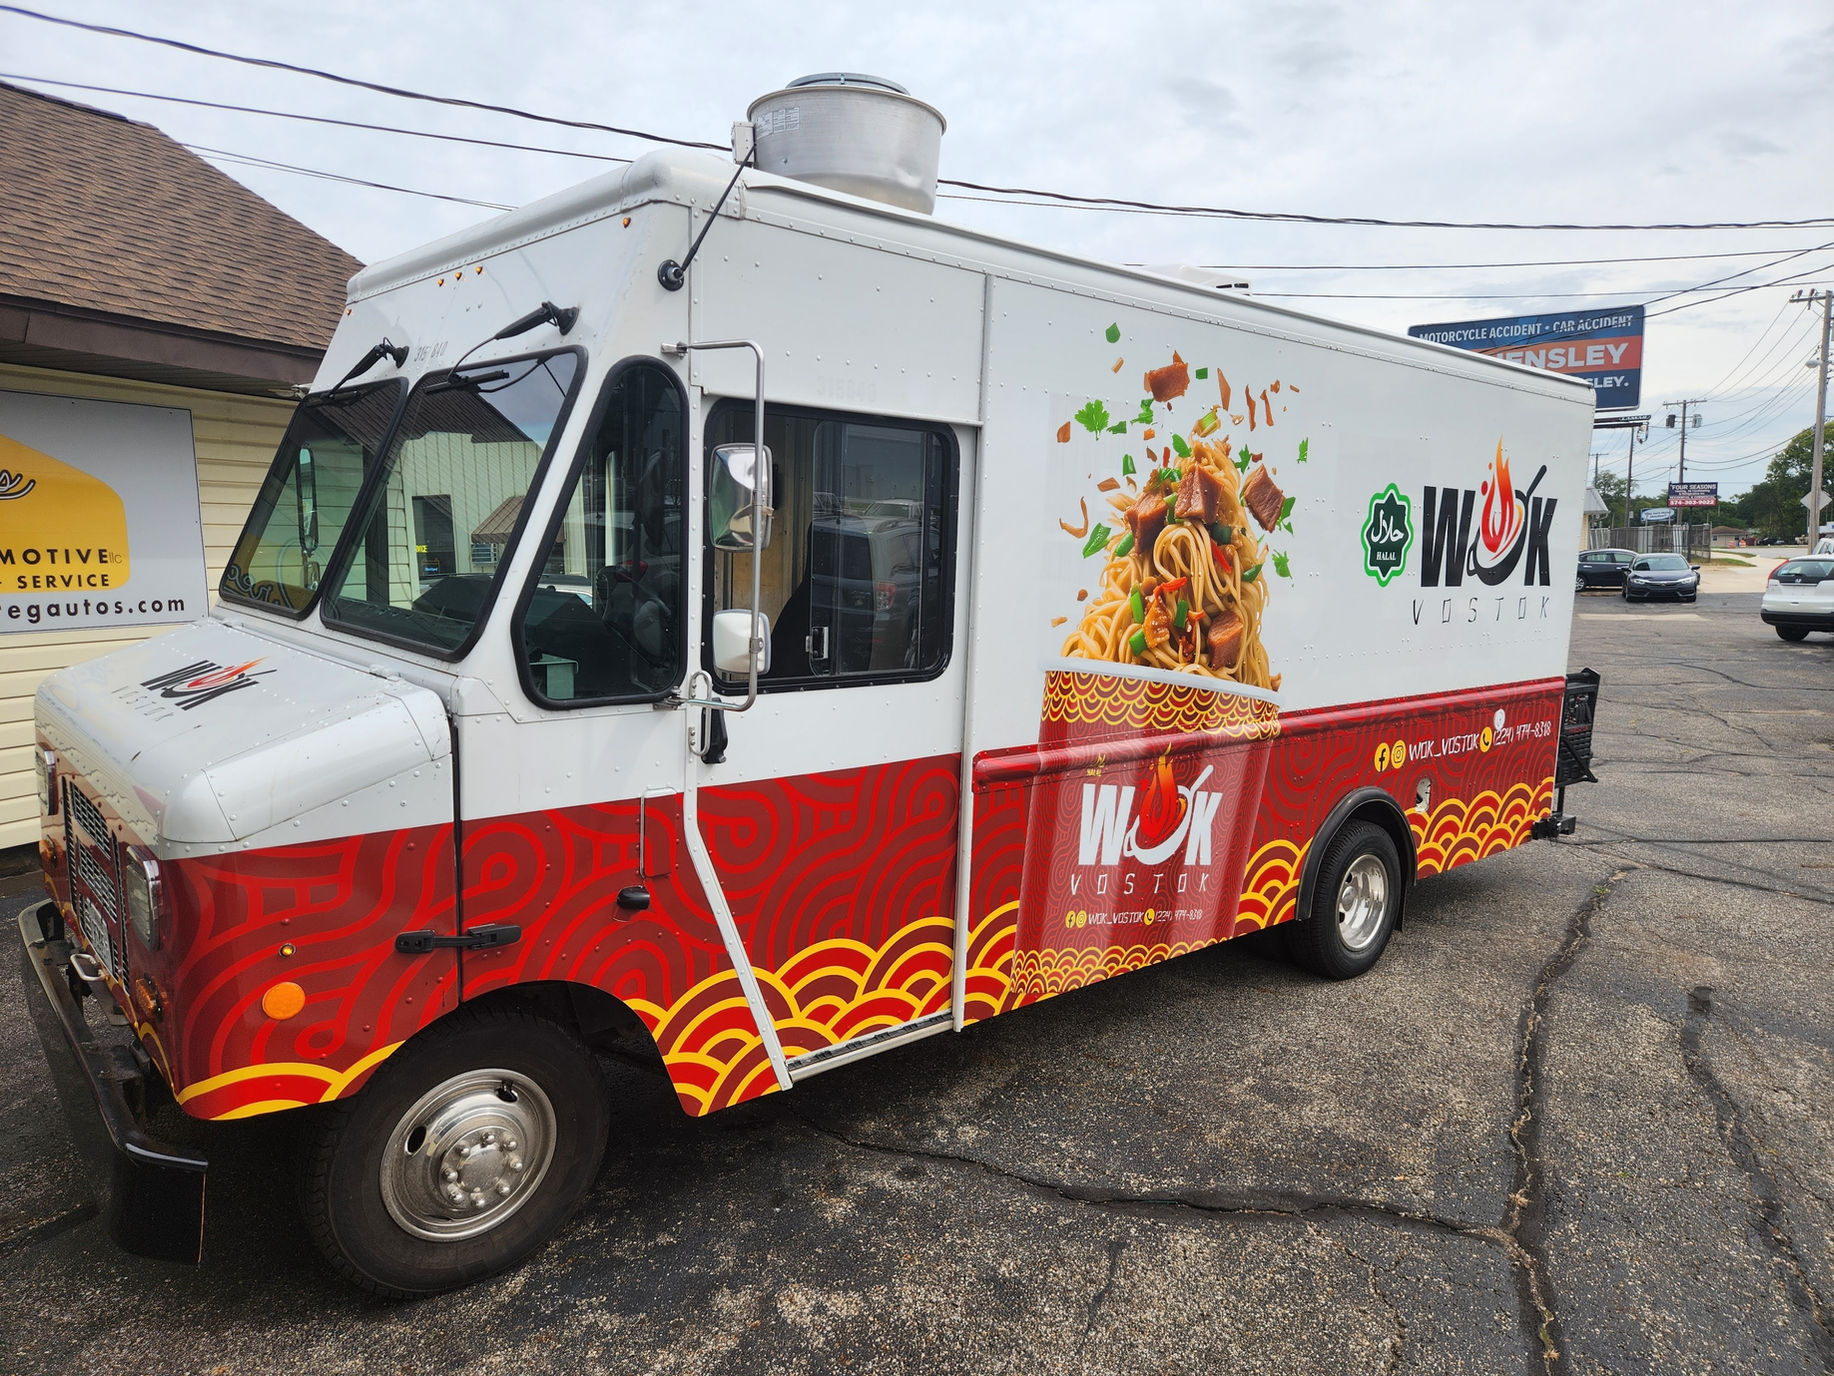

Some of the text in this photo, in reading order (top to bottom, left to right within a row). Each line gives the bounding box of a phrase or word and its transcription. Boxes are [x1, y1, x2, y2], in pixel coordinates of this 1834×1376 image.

[1489, 322, 1542, 339] ACCIDENT
[1553, 319, 1574, 332] CAR
[1579, 315, 1633, 331] ACCIDENT
[1497, 343, 1629, 369] ENSLEY
[1421, 464, 1558, 587] WOK
[1376, 551, 1397, 561] HALAL
[17, 574, 110, 589] SERVICE
[0, 599, 185, 624] egautos.com
[1412, 596, 1549, 625] VOSTOK
[1409, 732, 1480, 761] WOK_VOSTOK
[1078, 765, 1222, 865] WOK
[1070, 872, 1210, 895] VOSTOK
